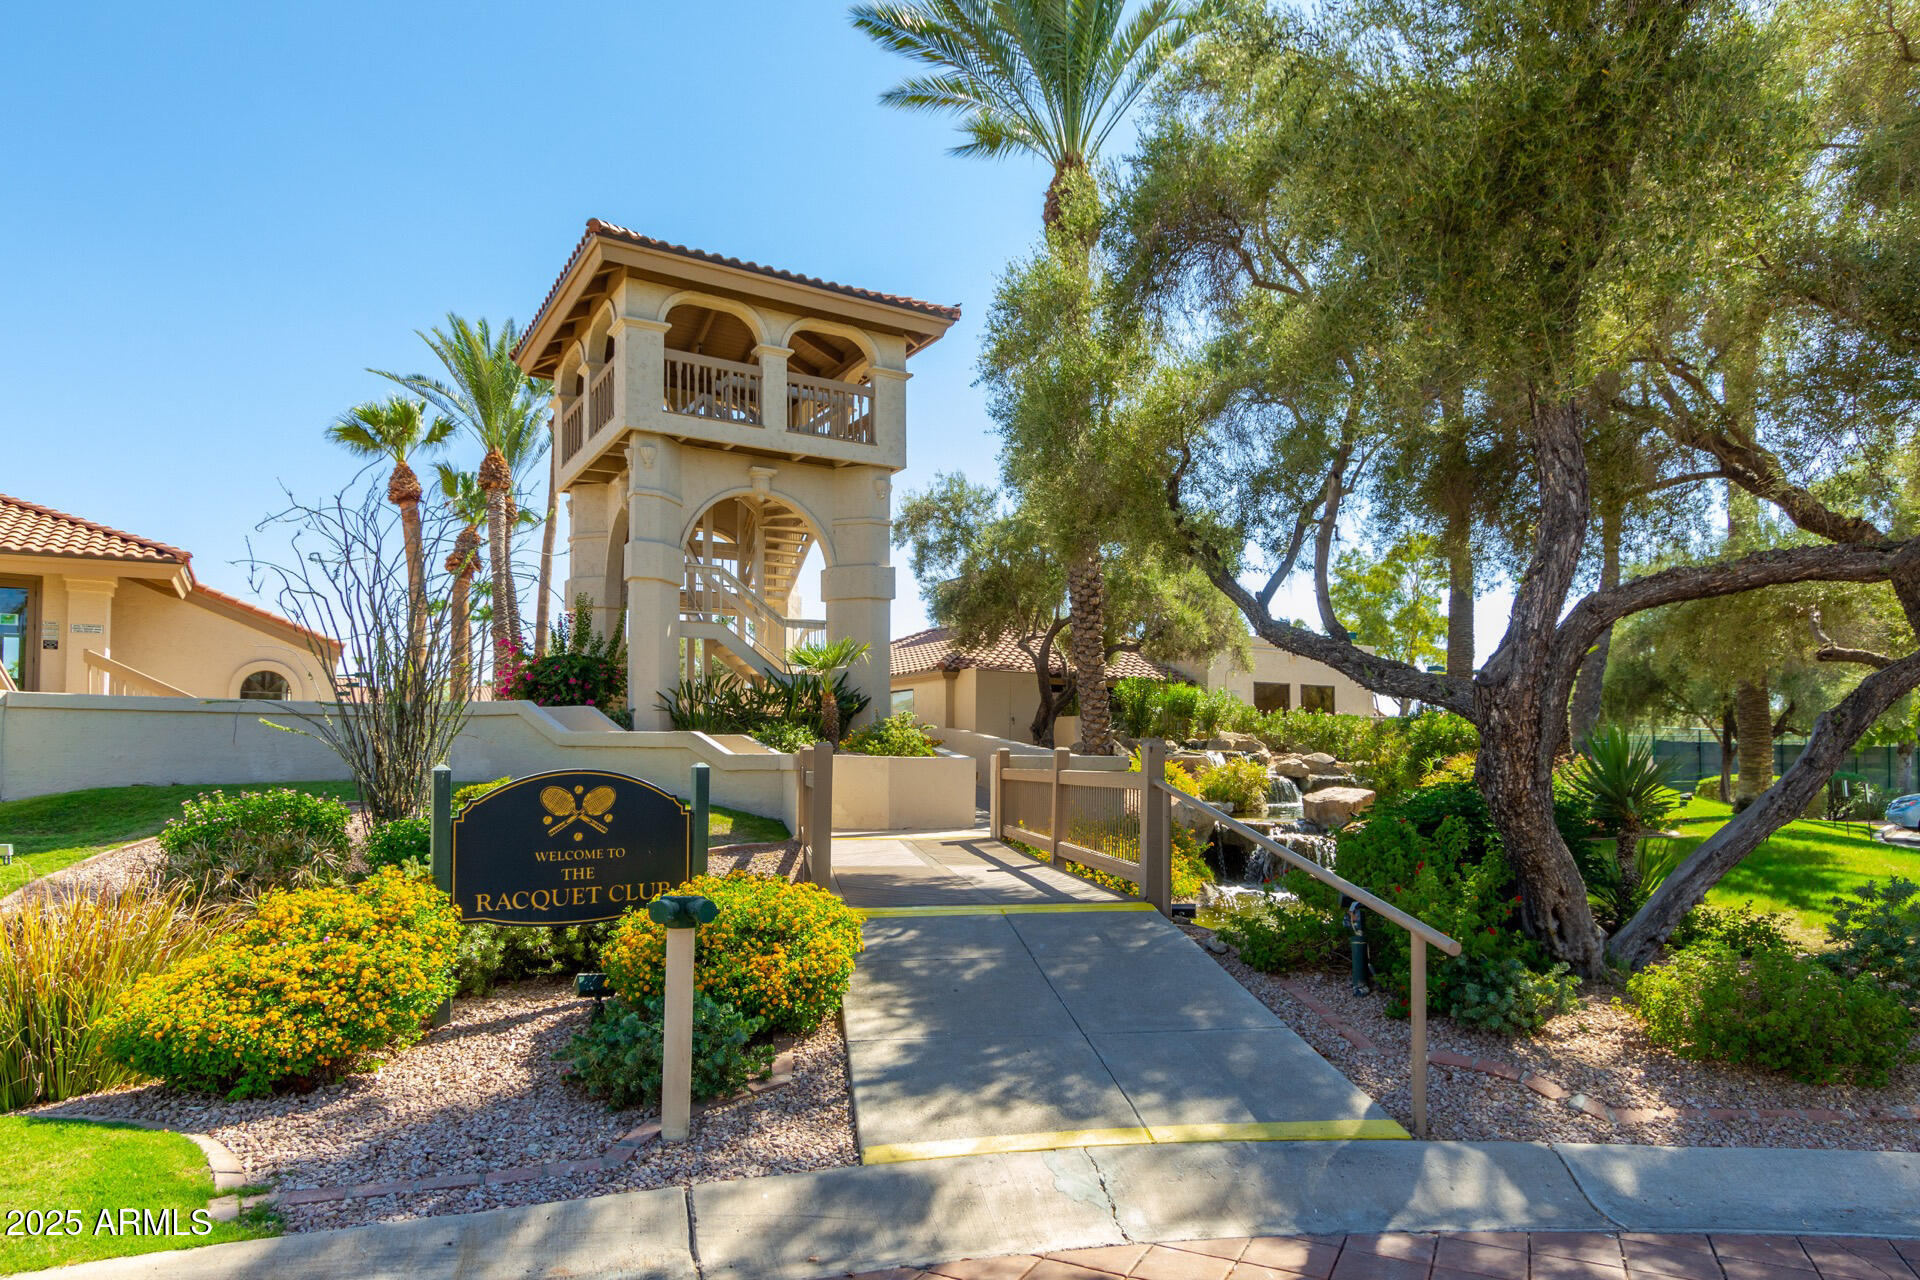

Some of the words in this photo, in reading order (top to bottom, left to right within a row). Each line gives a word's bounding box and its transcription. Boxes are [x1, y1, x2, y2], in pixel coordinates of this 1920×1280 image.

[535, 848, 604, 862] WELCOME
[606, 847, 626, 859] TO
[560, 866, 596, 881] THE
[474, 886, 602, 913] RACQUET
[608, 881, 671, 903] CLUB
